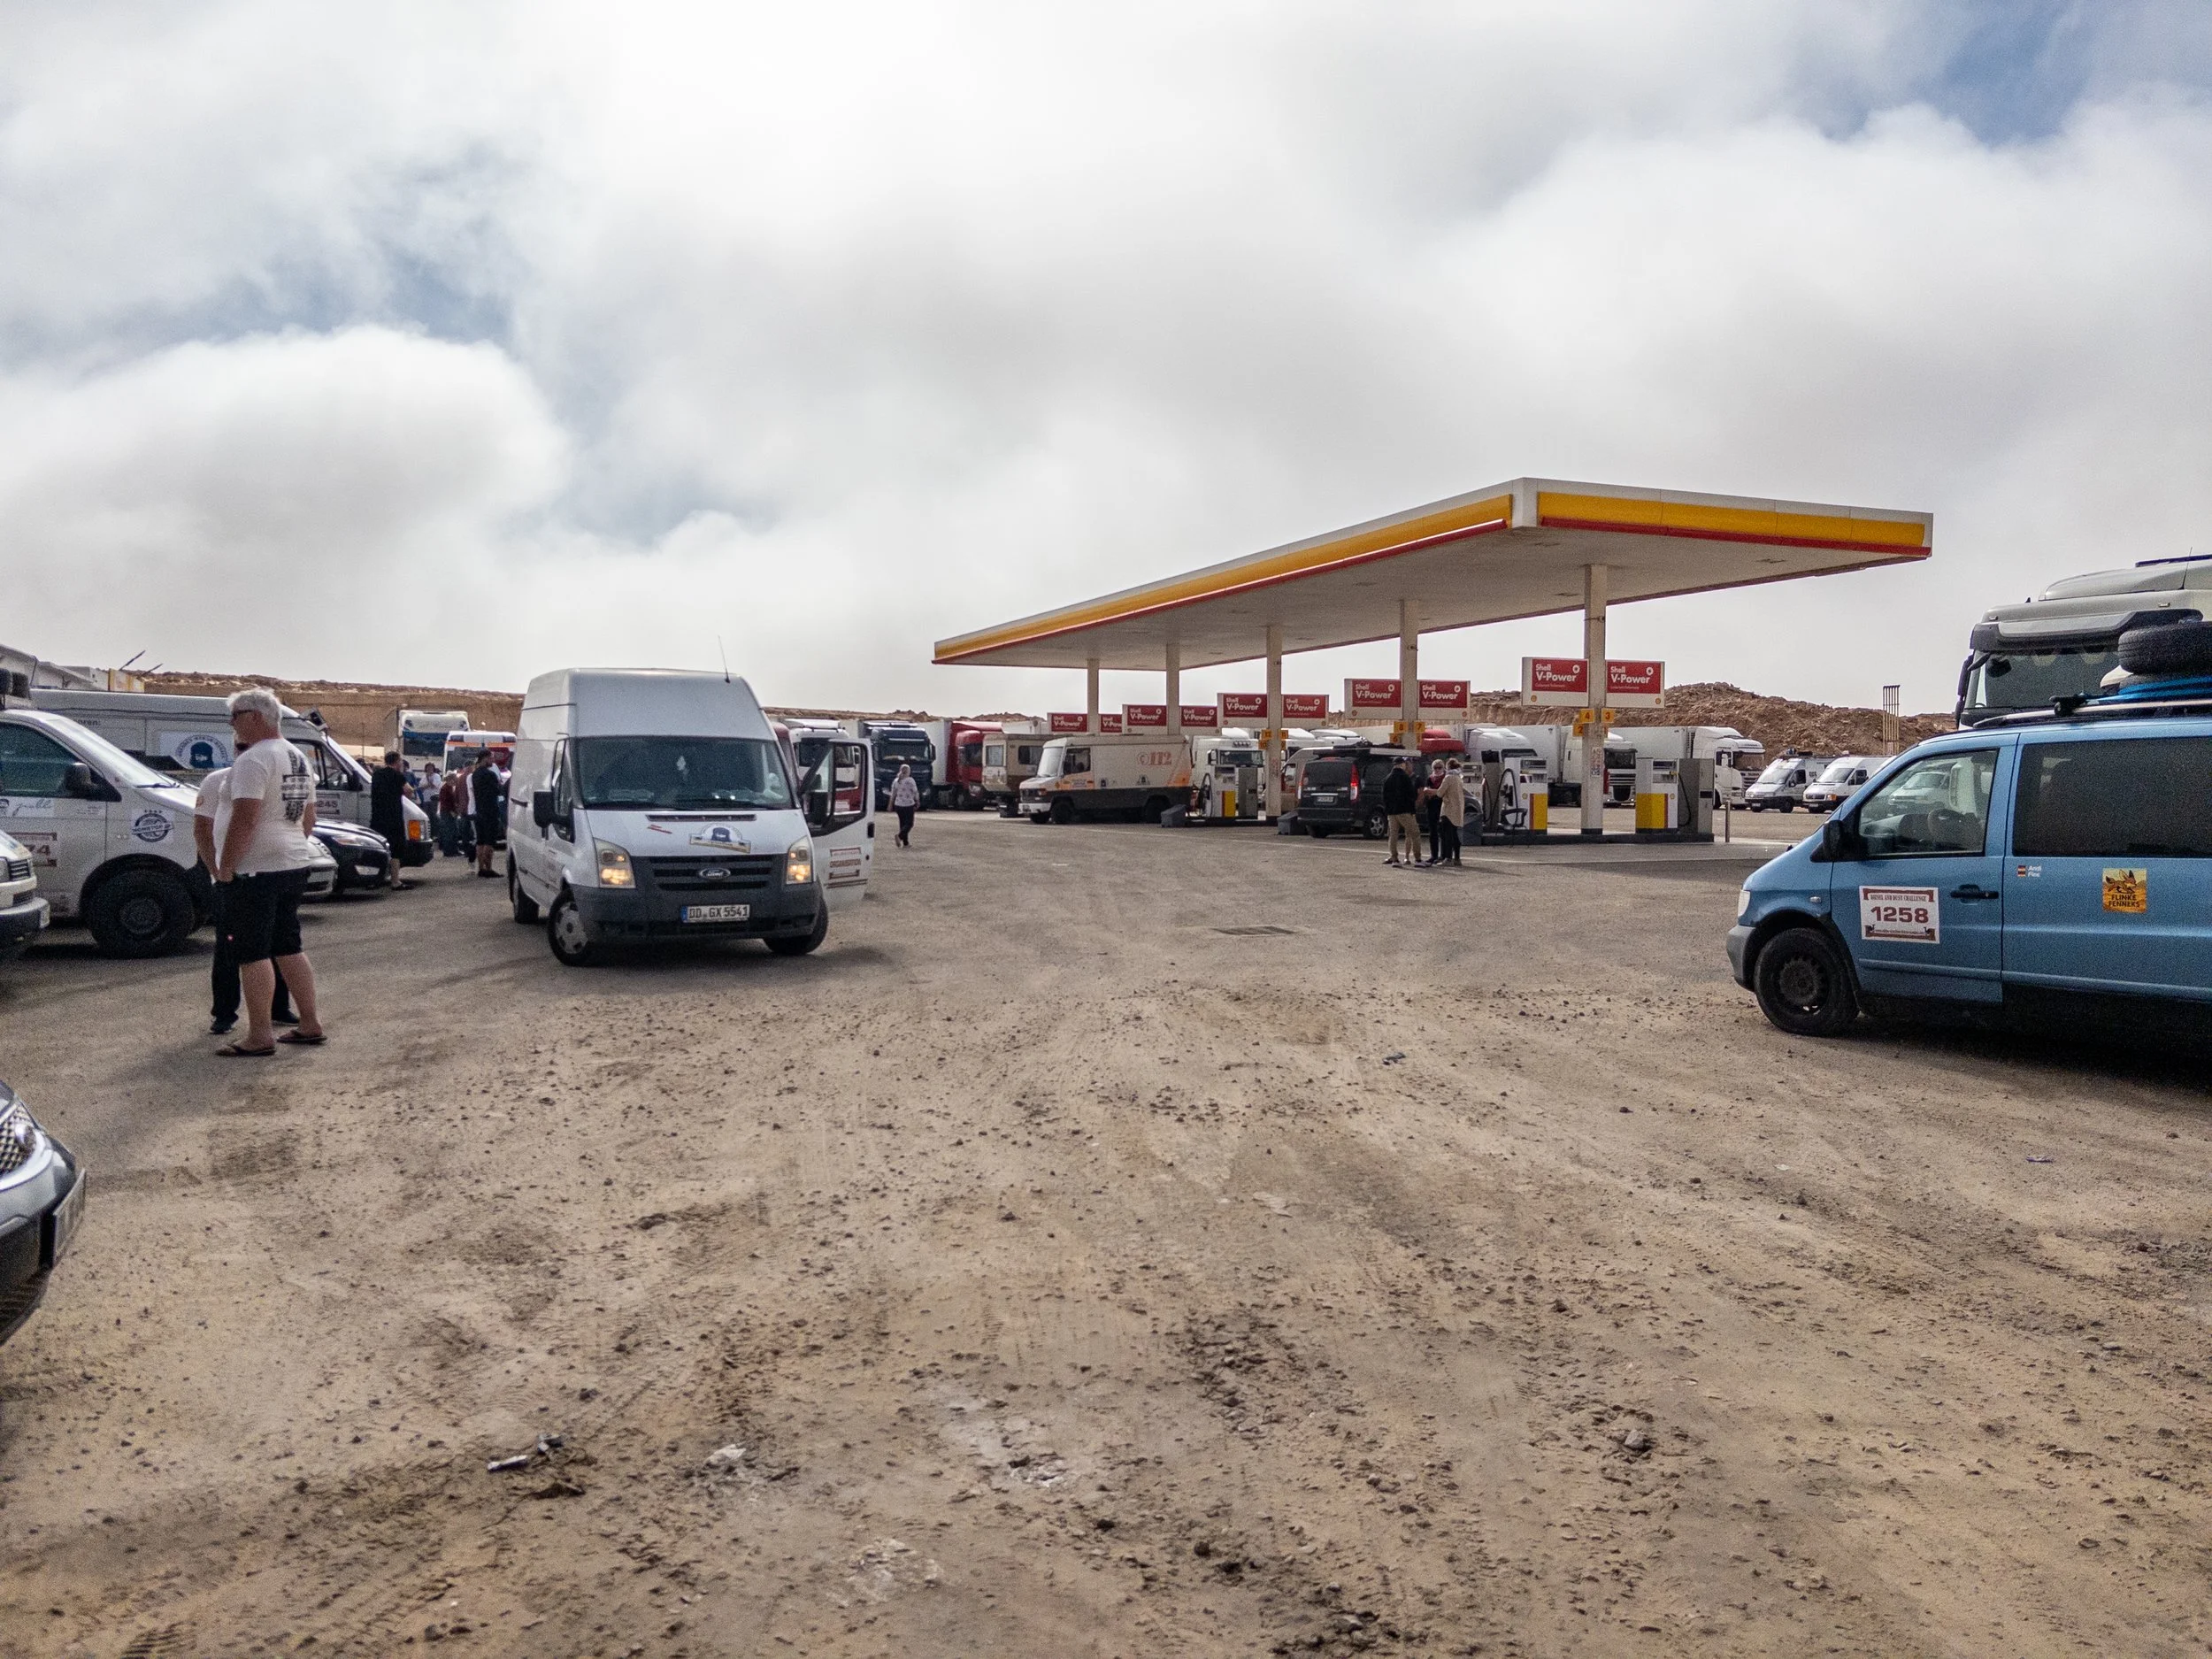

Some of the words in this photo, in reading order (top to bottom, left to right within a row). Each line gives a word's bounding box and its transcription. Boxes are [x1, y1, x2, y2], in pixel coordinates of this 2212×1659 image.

[1535, 672, 1577, 682] V-Power
[1610, 673, 1650, 684] V-Power
[1355, 690, 1392, 699] V-Power
[1422, 691, 1458, 700] V-Power
[688, 908, 702, 918] DD
[709, 907, 722, 918] GX
[723, 906, 749, 918] 5541
[1870, 906, 1929, 924] 1258
